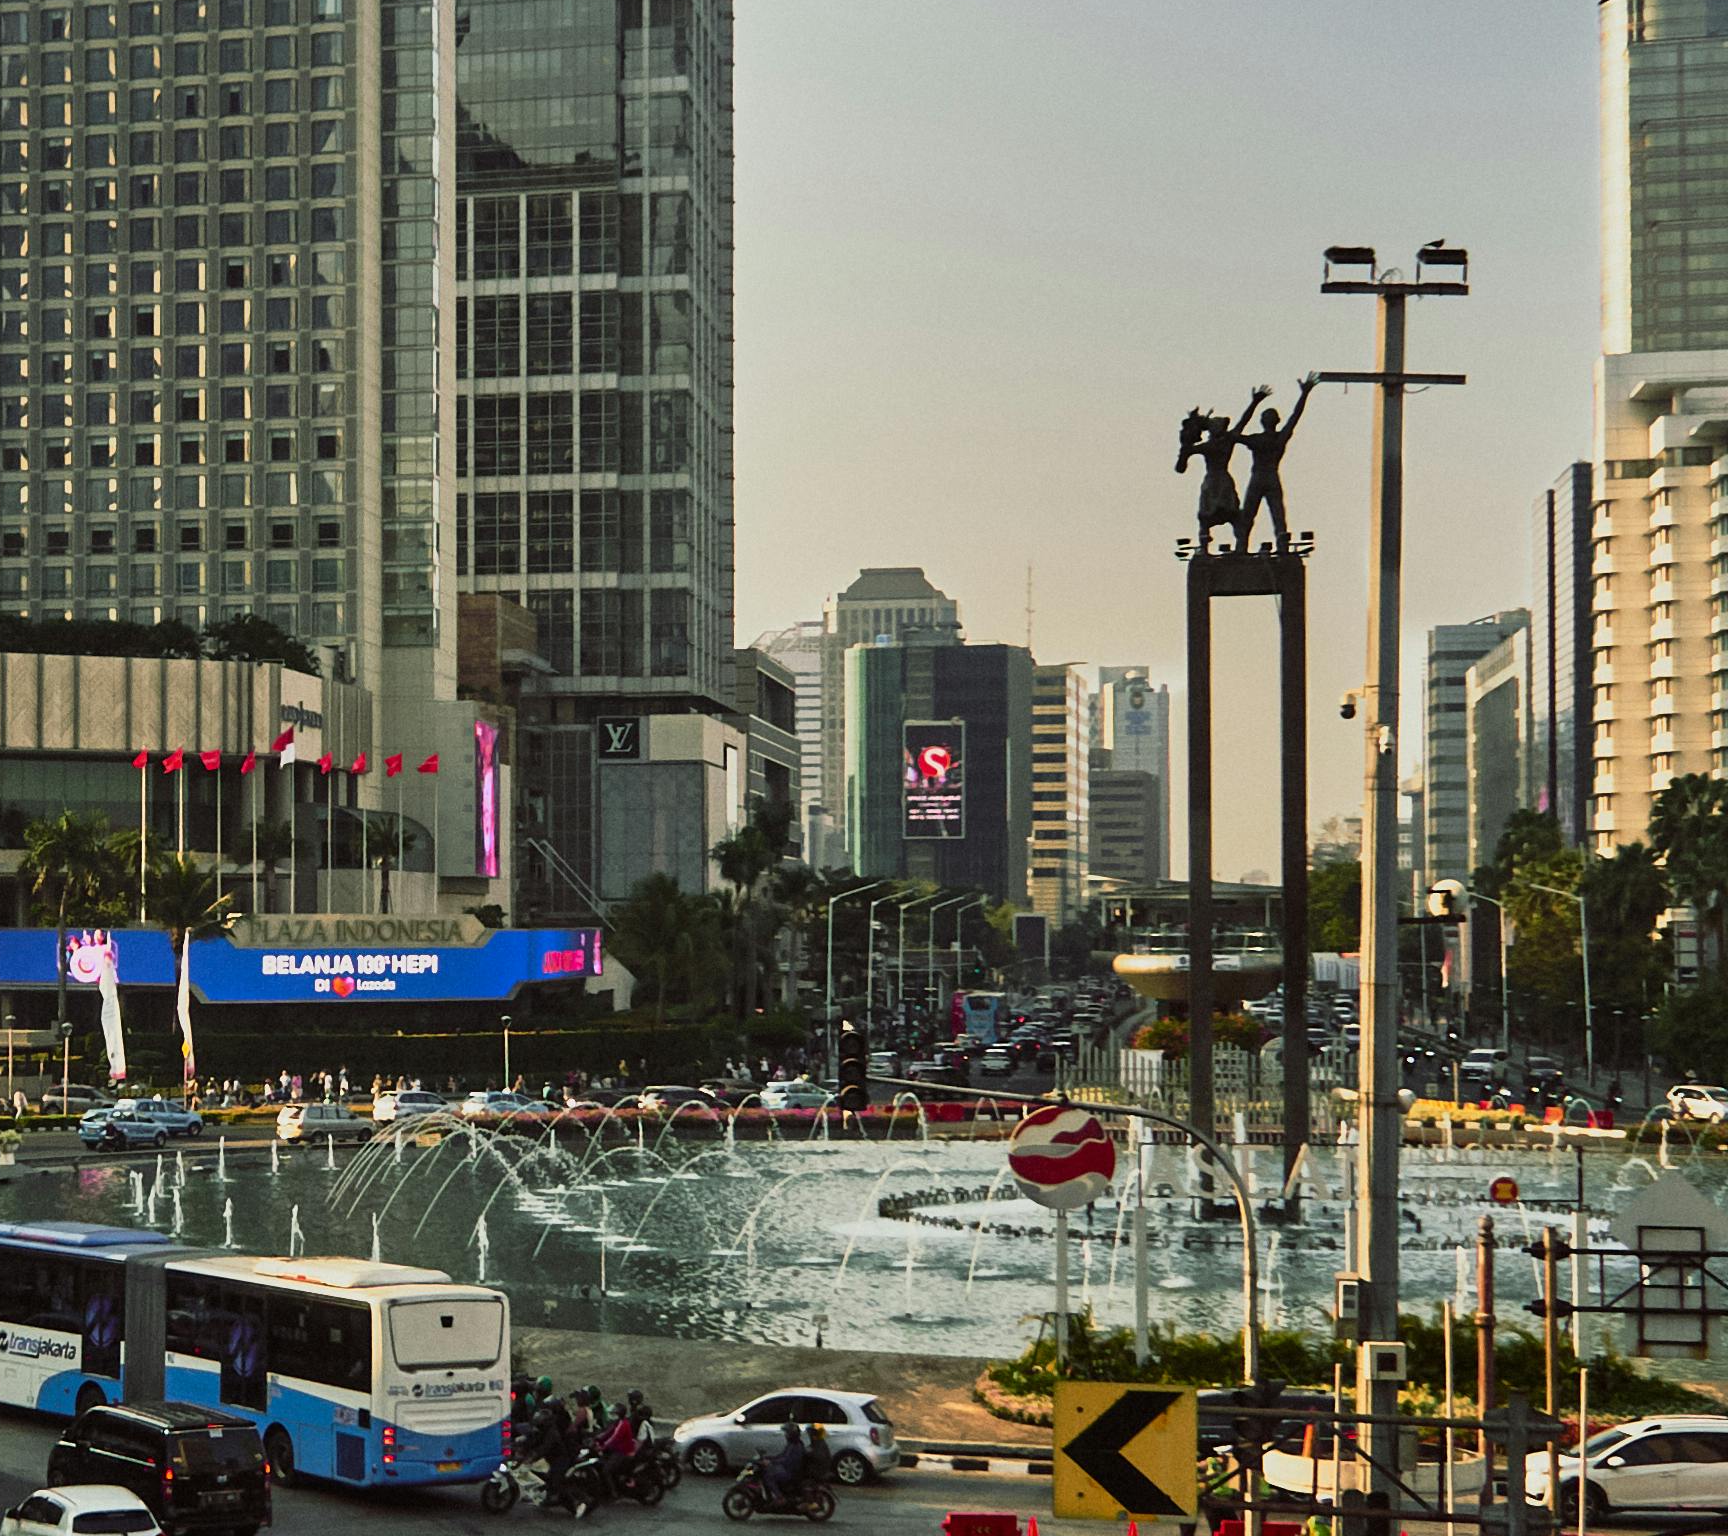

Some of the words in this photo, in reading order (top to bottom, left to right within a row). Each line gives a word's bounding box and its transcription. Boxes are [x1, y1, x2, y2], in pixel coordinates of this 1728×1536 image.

[248, 919, 326, 944] PLAZA
[335, 918, 464, 943] INDONESIA
[261, 954, 355, 975] BELANJA
[390, 954, 439, 974] HEPI
[314, 978, 330, 992] DI
[8, 1331, 77, 1360] transjakarta
